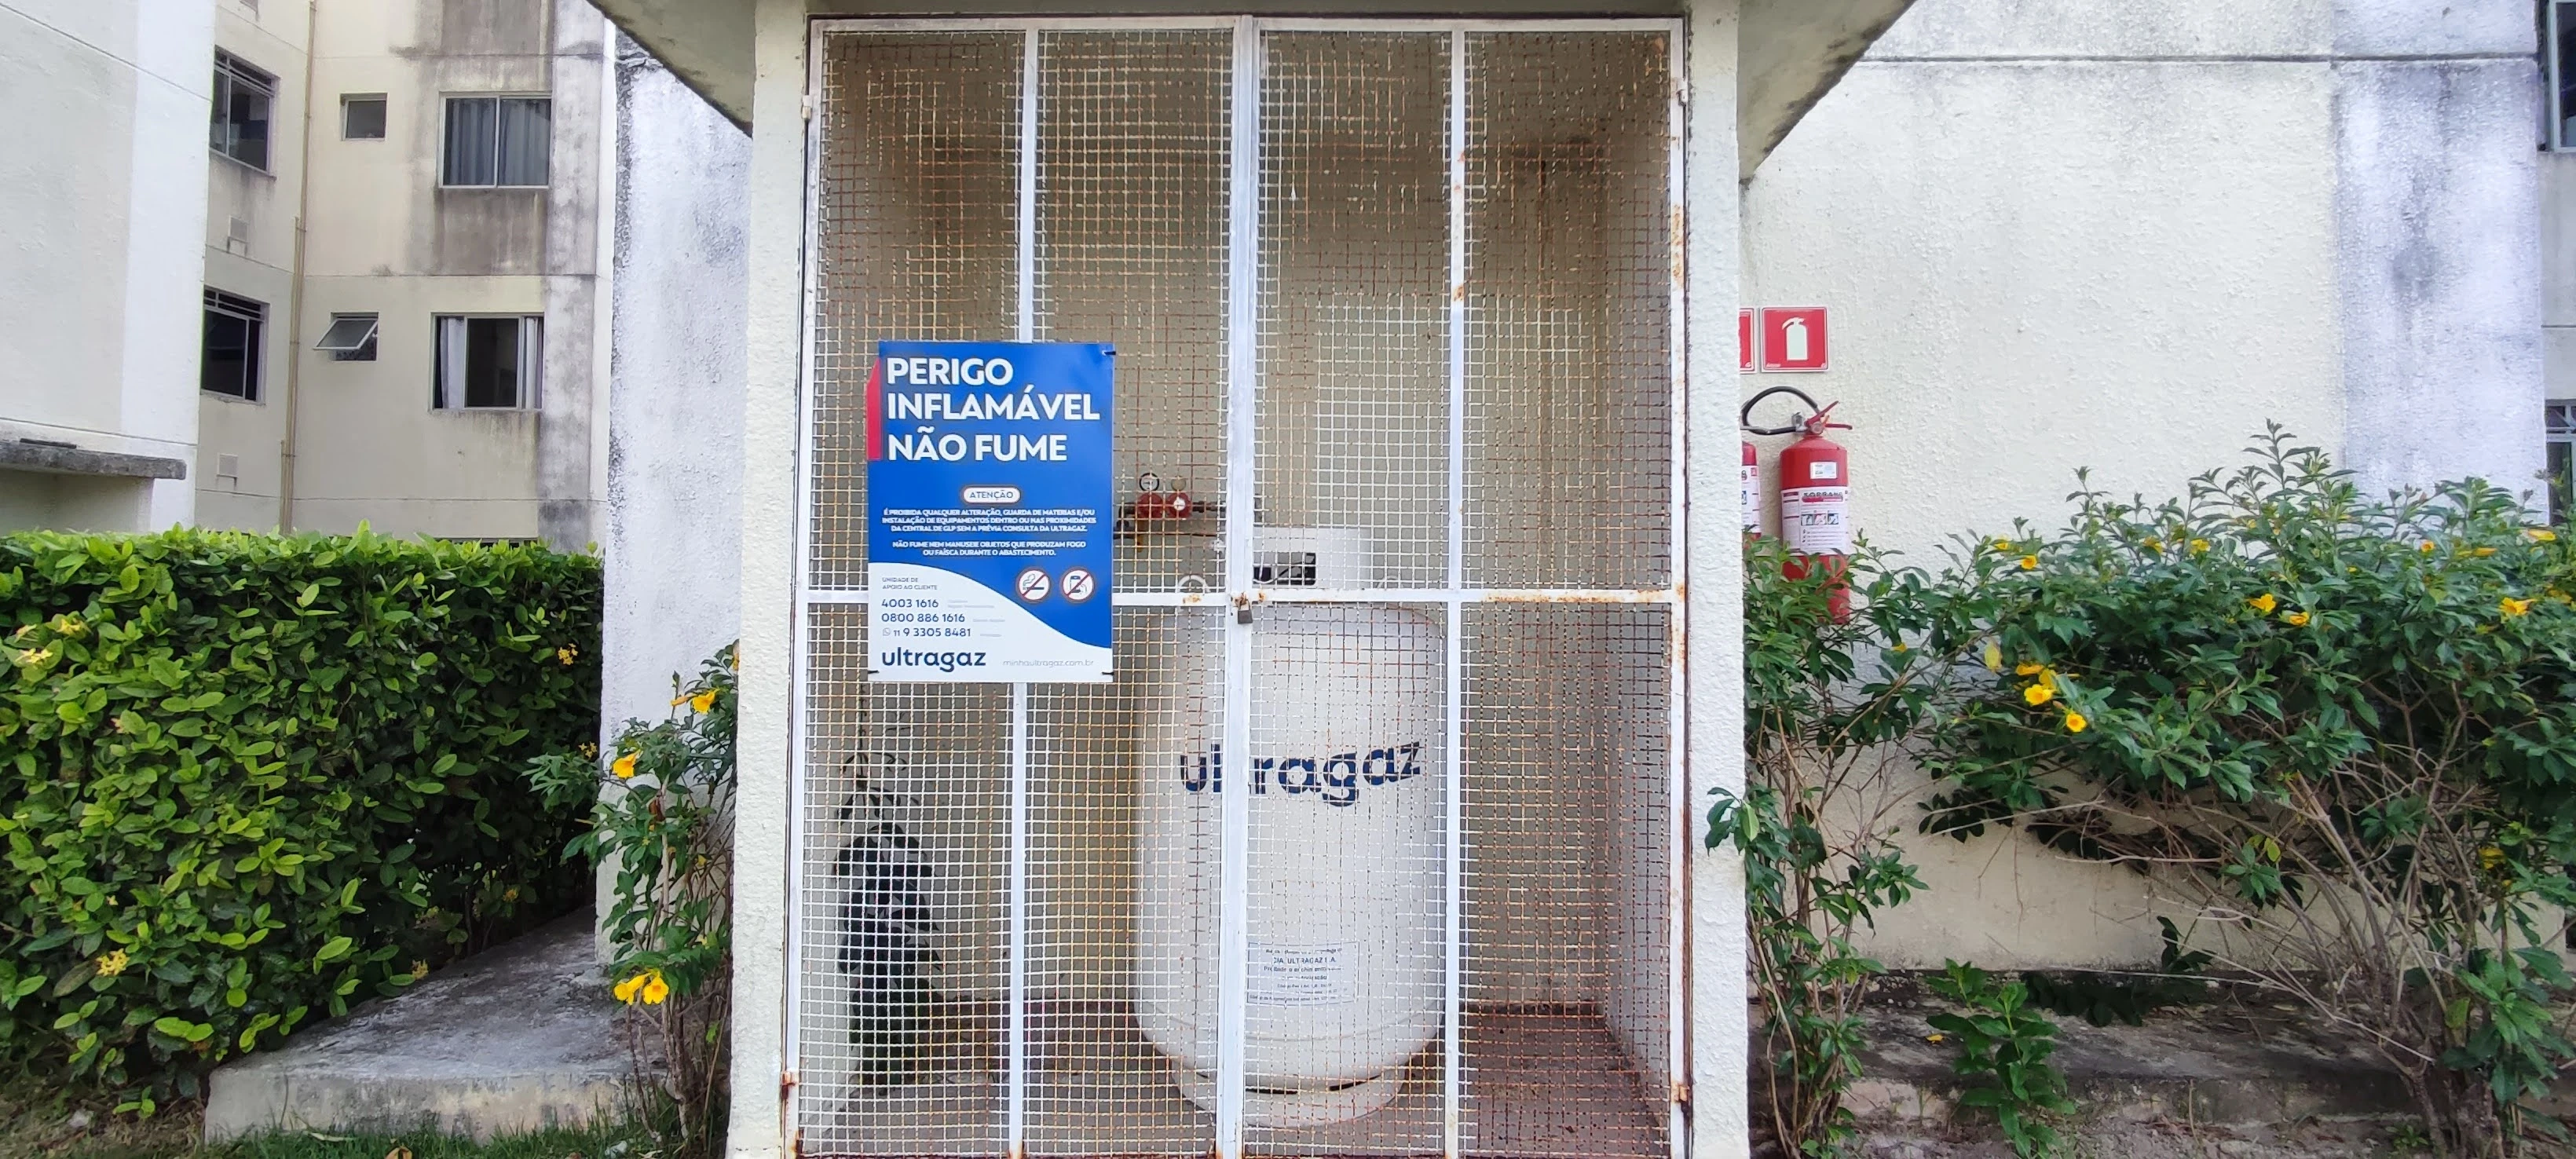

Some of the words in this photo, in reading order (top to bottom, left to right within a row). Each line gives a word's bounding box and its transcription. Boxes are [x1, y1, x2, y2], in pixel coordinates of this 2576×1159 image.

[887, 357, 1014, 386] PERIGO
[887, 384, 1100, 421] INFLAMÁVEL
[887, 426, 968, 462] NÃO
[975, 434, 1067, 462] FUME
[968, 489, 1014, 500] ATENÇÃO
[881, 516, 925, 525] INSTALAÇÃO
[892, 539, 909, 548] NÃO
[935, 547, 959, 556] FAÍSCA
[881, 598, 913, 608] 4003
[915, 598, 939, 608] 1616
[881, 612, 914, 622] 0800
[917, 613, 939, 622] 886
[942, 613, 965, 623] 1616
[902, 627, 910, 637] 9
[913, 627, 942, 637] 3305
[944, 627, 971, 637] 8481
[881, 647, 986, 672] ultragaz
[1002, 659, 1094, 668] minhaultragaz.com.br
[1180, 741, 1421, 807] ulragaz
